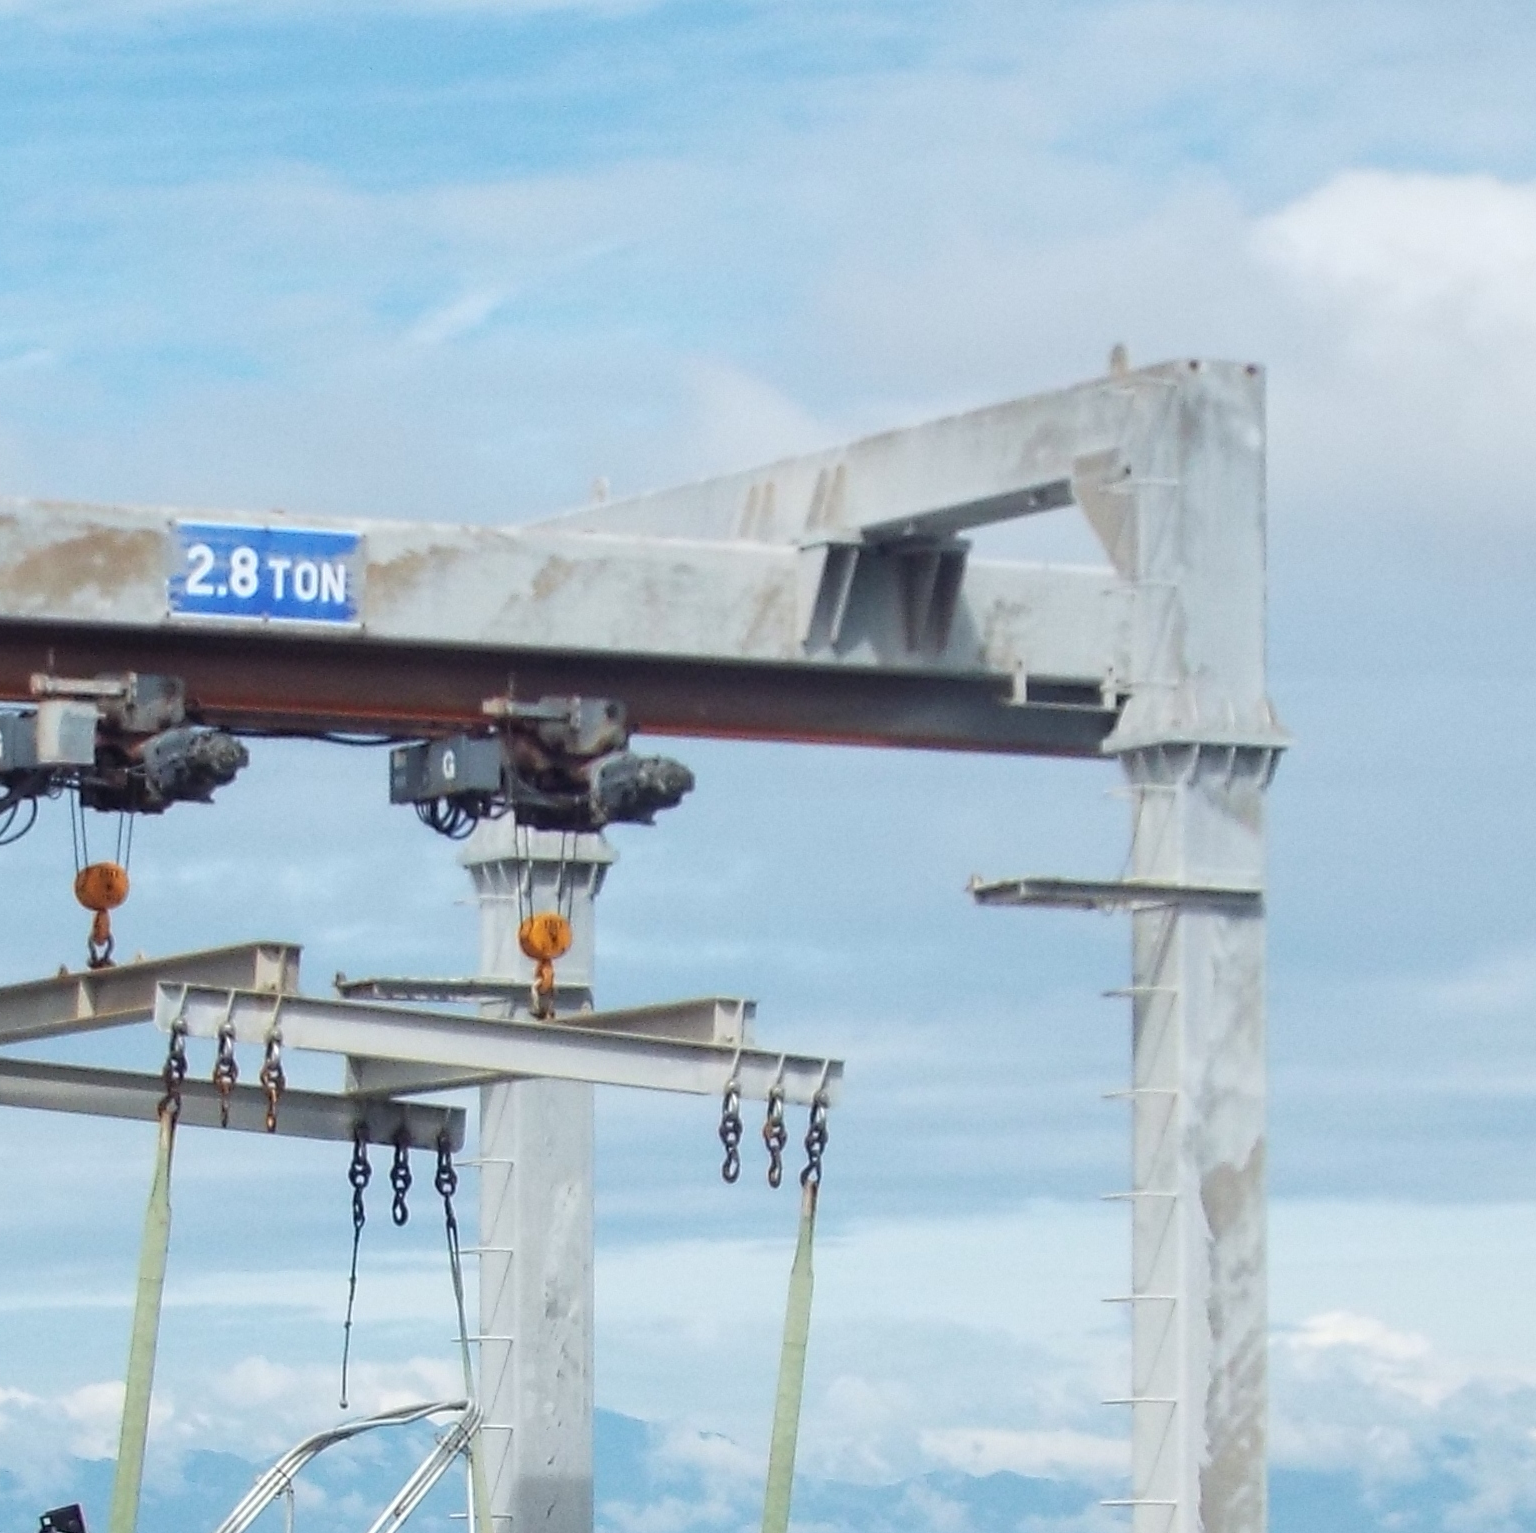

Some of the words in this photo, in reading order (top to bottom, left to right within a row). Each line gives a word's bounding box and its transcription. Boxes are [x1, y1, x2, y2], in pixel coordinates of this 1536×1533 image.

[186, 543, 259, 599] 2.8
[268, 558, 346, 605] TON
[441, 749, 456, 780] G
